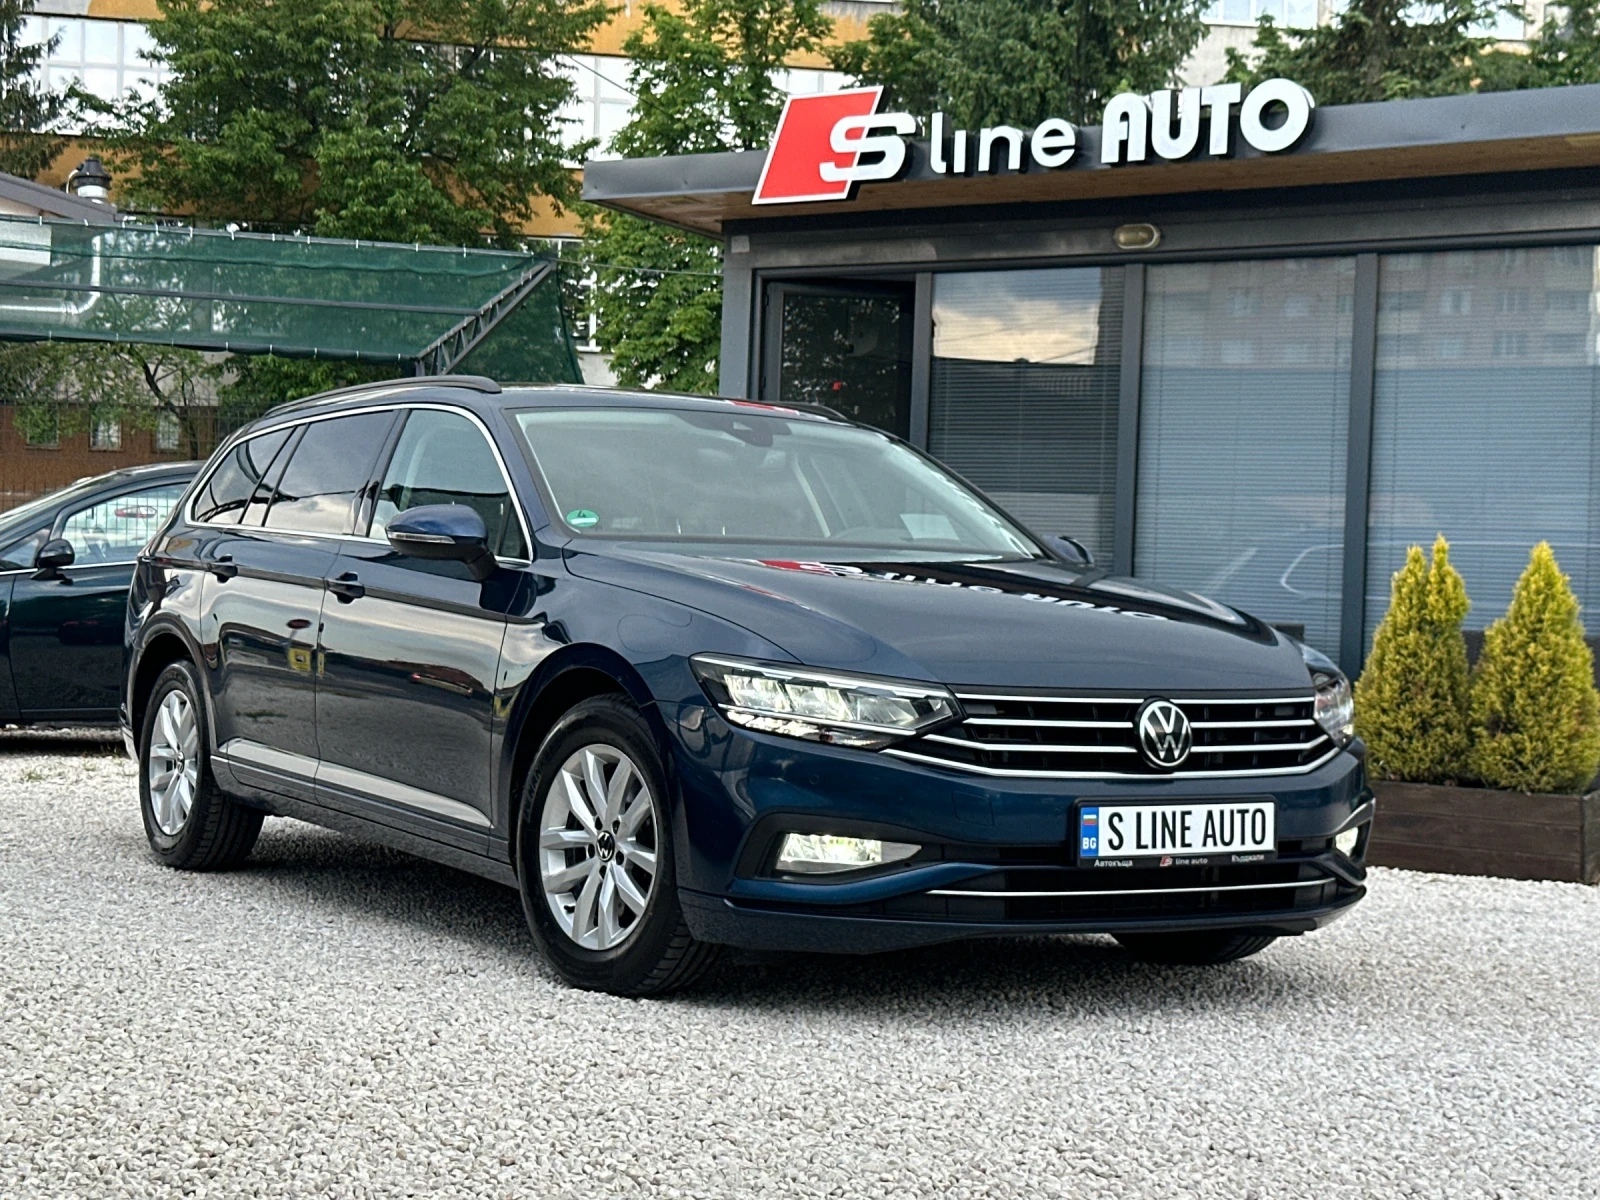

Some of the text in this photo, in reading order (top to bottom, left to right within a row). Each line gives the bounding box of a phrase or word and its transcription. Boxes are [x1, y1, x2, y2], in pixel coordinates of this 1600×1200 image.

[819, 78, 1314, 182] S line AUTO
[1107, 808, 1266, 850] S LINE AUTO
[1082, 837, 1097, 850] BG
[1191, 857, 1208, 865] auto
